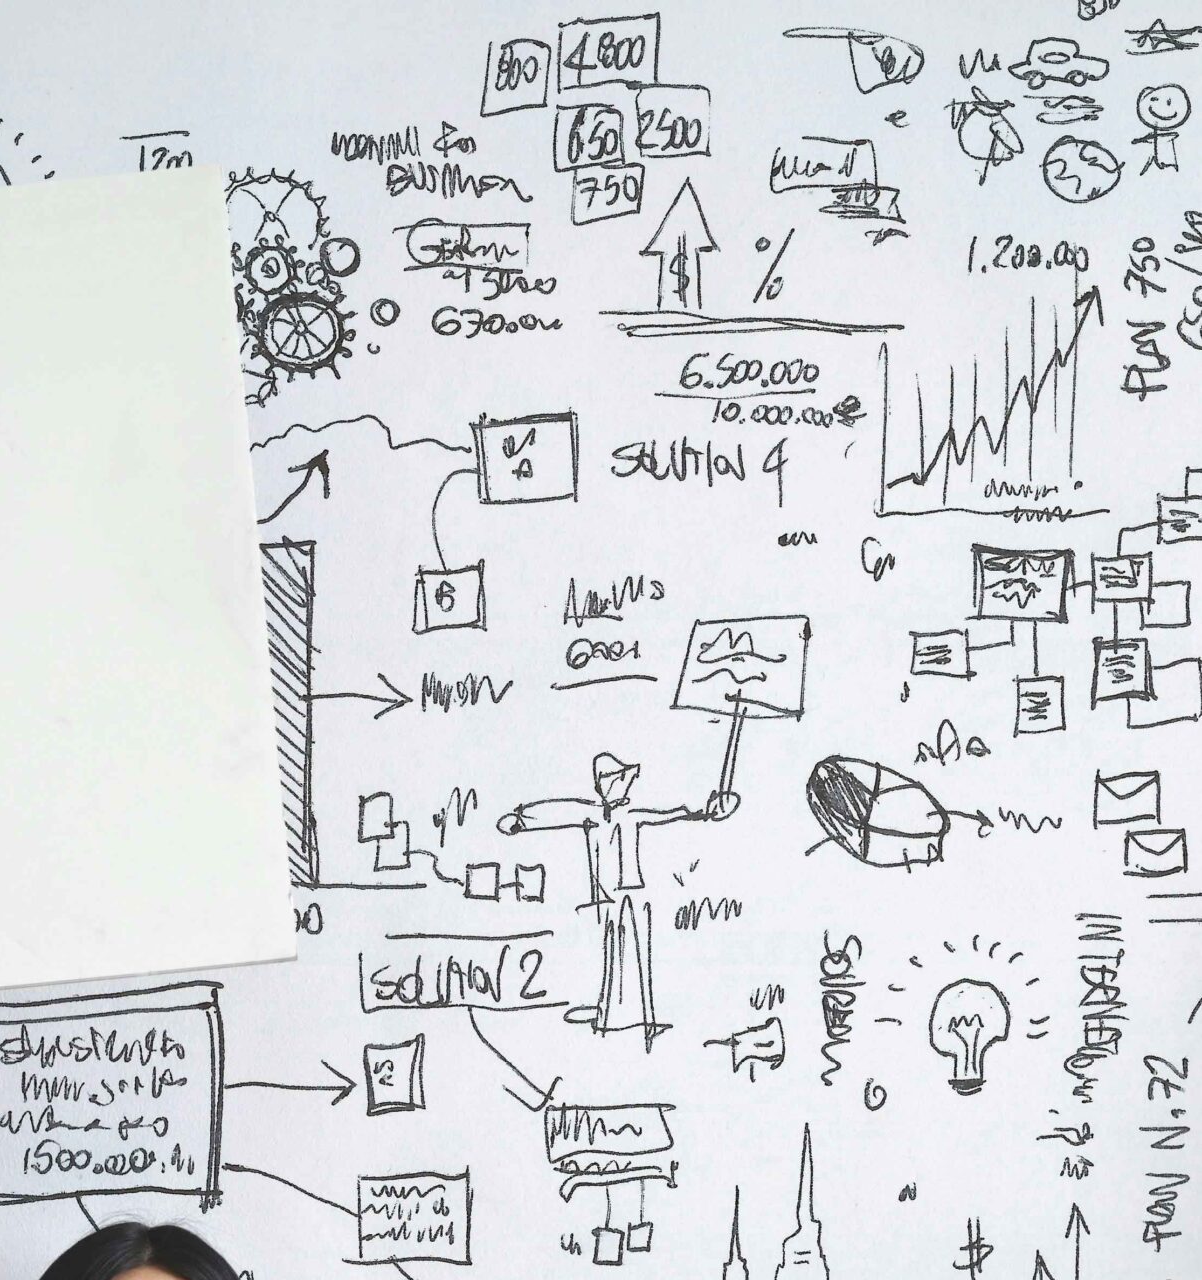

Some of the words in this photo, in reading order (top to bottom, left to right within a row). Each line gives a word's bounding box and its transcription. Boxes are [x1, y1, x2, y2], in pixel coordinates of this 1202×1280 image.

[576, 175, 640, 208] 750
[679, 353, 820, 389] 6.500.000
[519, 949, 547, 998] 2
